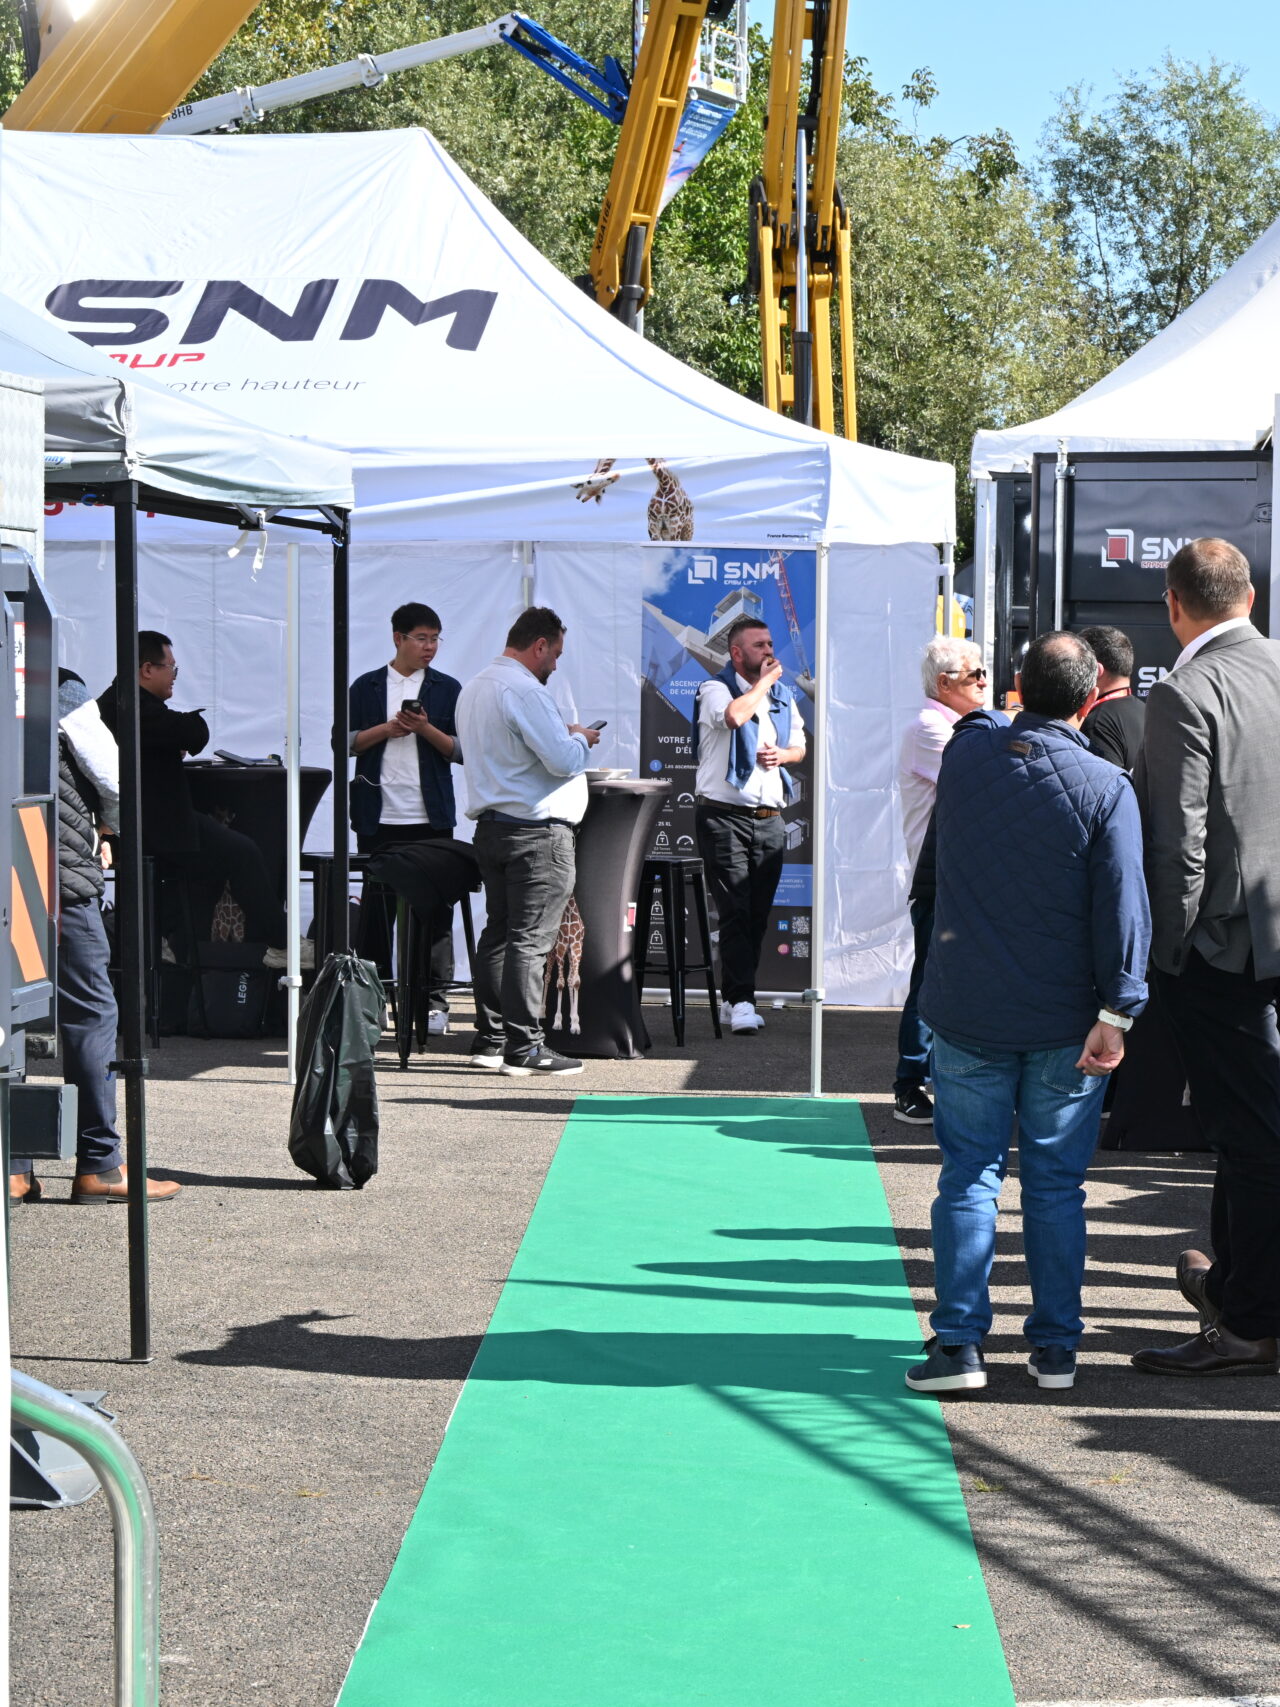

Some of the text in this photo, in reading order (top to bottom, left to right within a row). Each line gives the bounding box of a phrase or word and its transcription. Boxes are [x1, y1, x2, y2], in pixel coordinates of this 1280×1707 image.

[167, 104, 193, 121] 8HB
[45, 278, 499, 352] SNM
[166, 378, 367, 393] otre hauteur
[1141, 537, 1192, 560] SN
[724, 562, 780, 580] SNM
[657, 736, 685, 744] VOTRE
